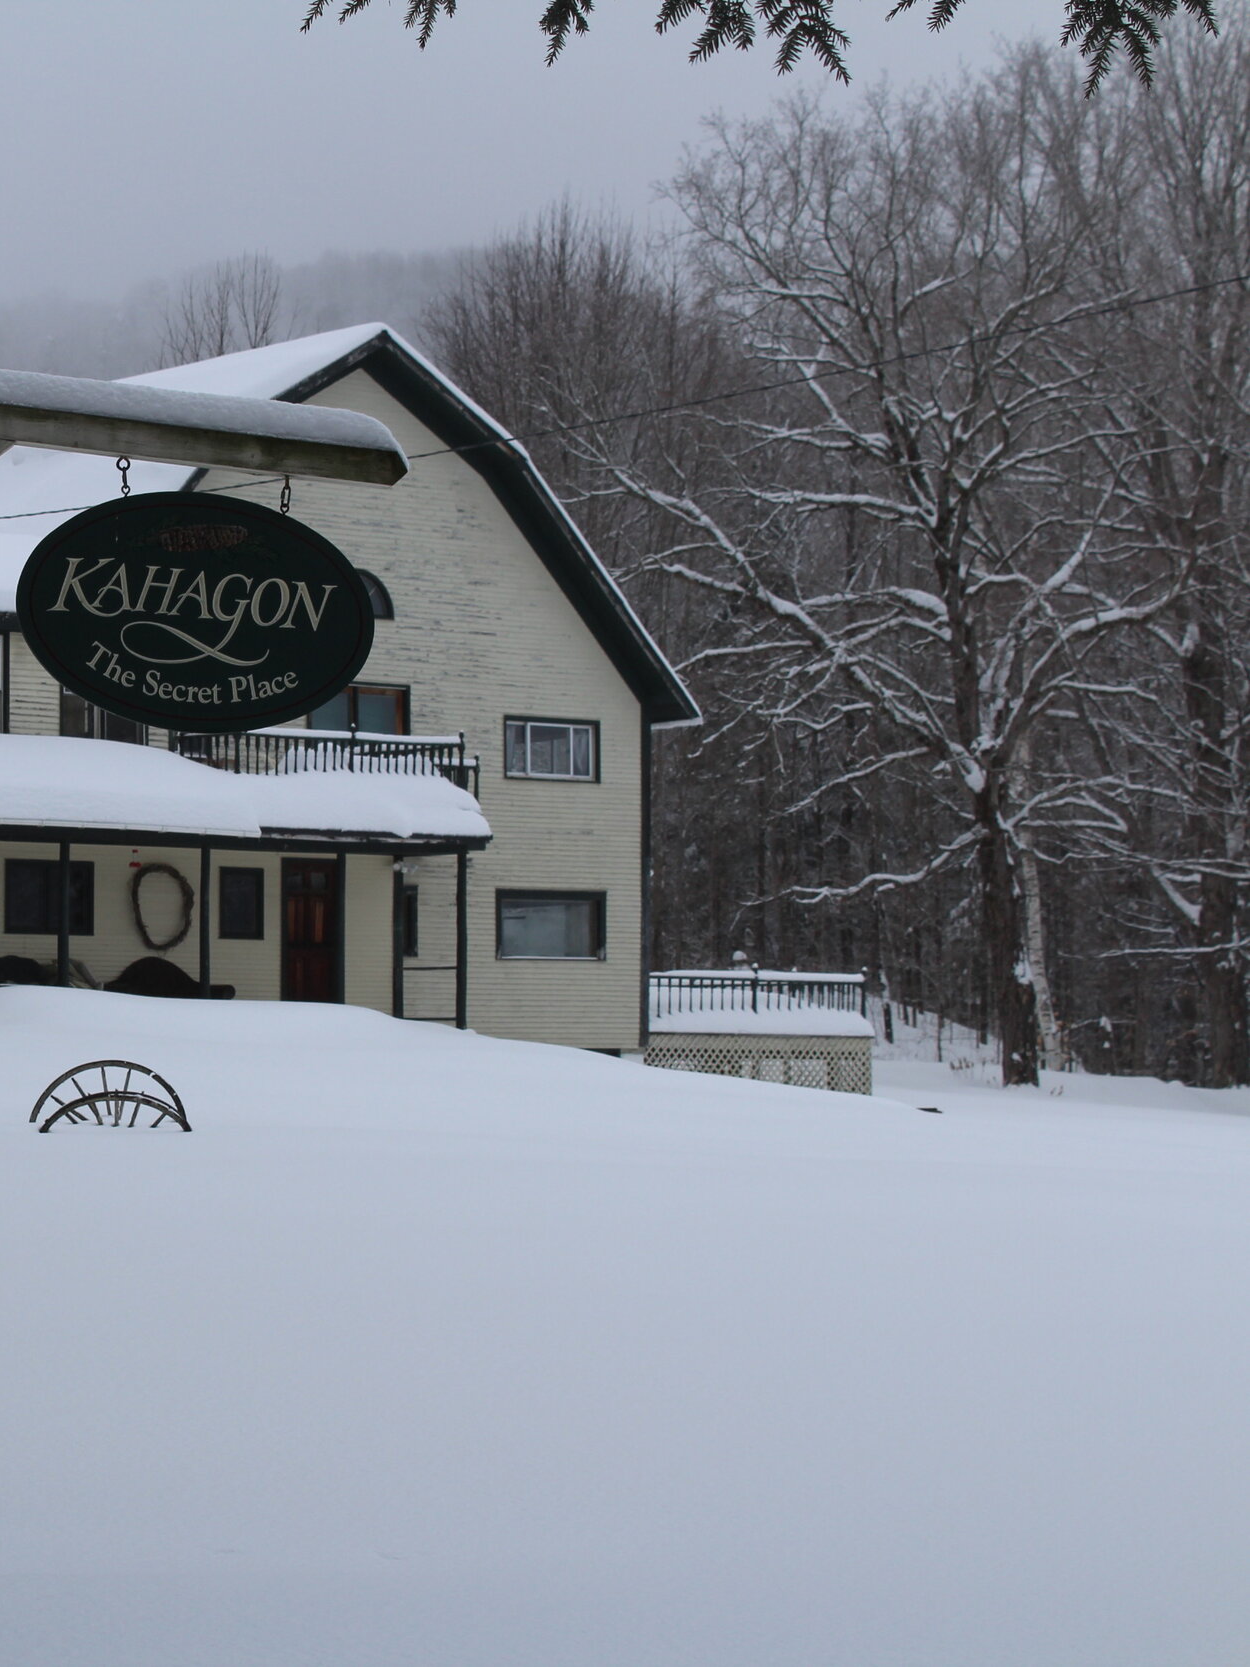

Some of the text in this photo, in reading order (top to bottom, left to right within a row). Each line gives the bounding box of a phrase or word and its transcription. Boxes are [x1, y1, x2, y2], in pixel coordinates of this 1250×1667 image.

[47, 557, 338, 666] KAHAGON
[85, 641, 299, 705] The Secret Place
